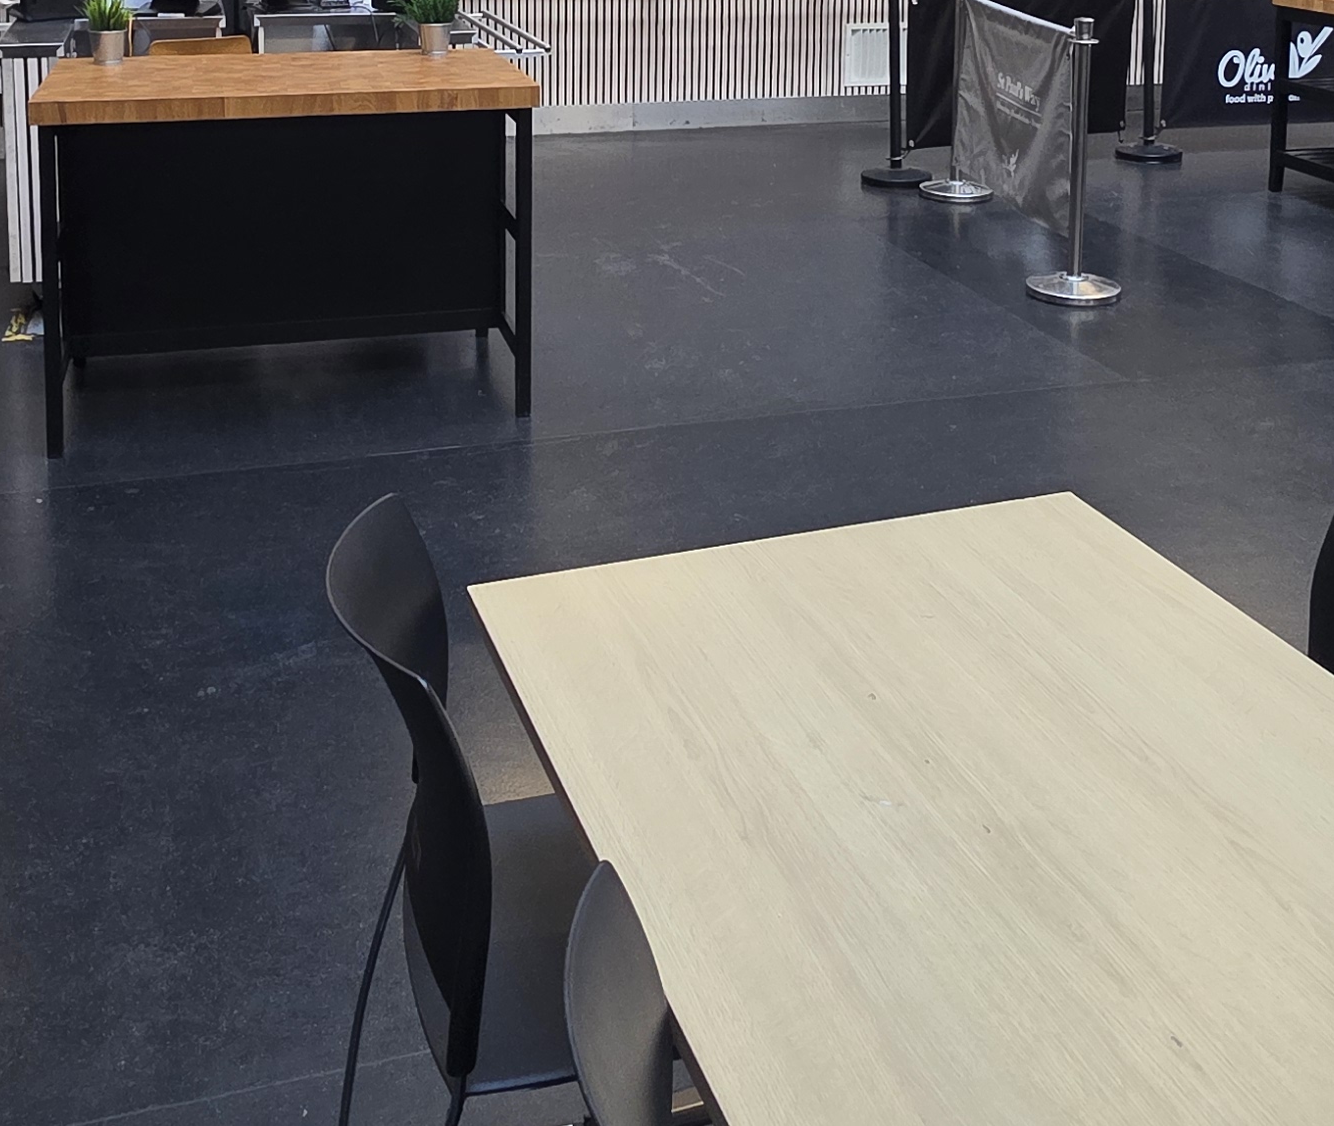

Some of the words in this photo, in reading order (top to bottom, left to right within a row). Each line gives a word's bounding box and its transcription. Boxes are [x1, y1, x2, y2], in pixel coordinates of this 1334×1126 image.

[1217, 47, 1276, 88] Oliv
[1243, 82, 1272, 92] dini
[1225, 94, 1246, 104] food
[1246, 93, 1267, 103] with
